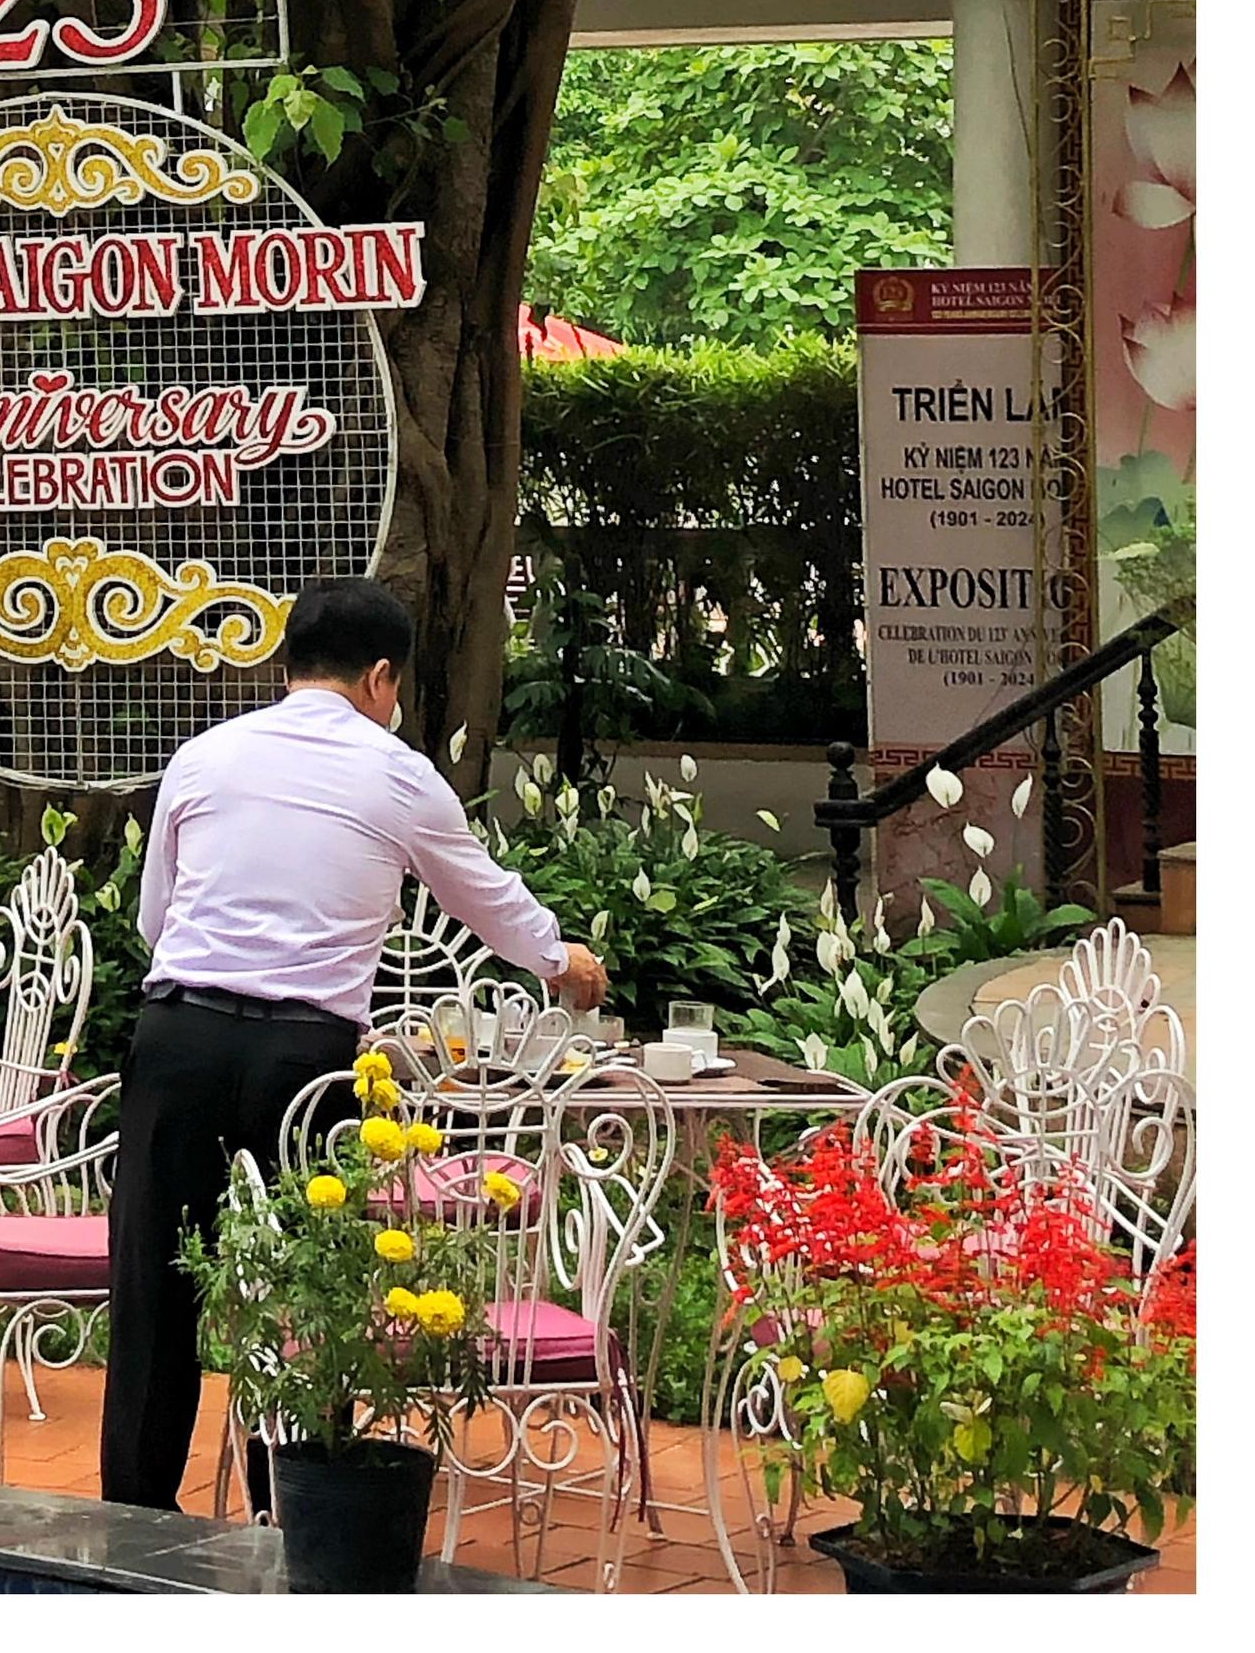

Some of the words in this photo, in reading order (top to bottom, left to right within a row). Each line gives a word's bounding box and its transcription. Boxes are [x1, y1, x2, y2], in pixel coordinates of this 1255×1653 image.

[196, 225, 426, 313] MORIN
[989, 447, 1020, 469] 123
[881, 477, 945, 500] HOTEL
[949, 478, 1025, 500] SAIGON
[929, 510, 978, 529] (1901
[968, 626, 983, 643] DU
[908, 648, 926, 665] DE
[984, 648, 1033, 666] SAIGON
[942, 671, 984, 688] (1901
